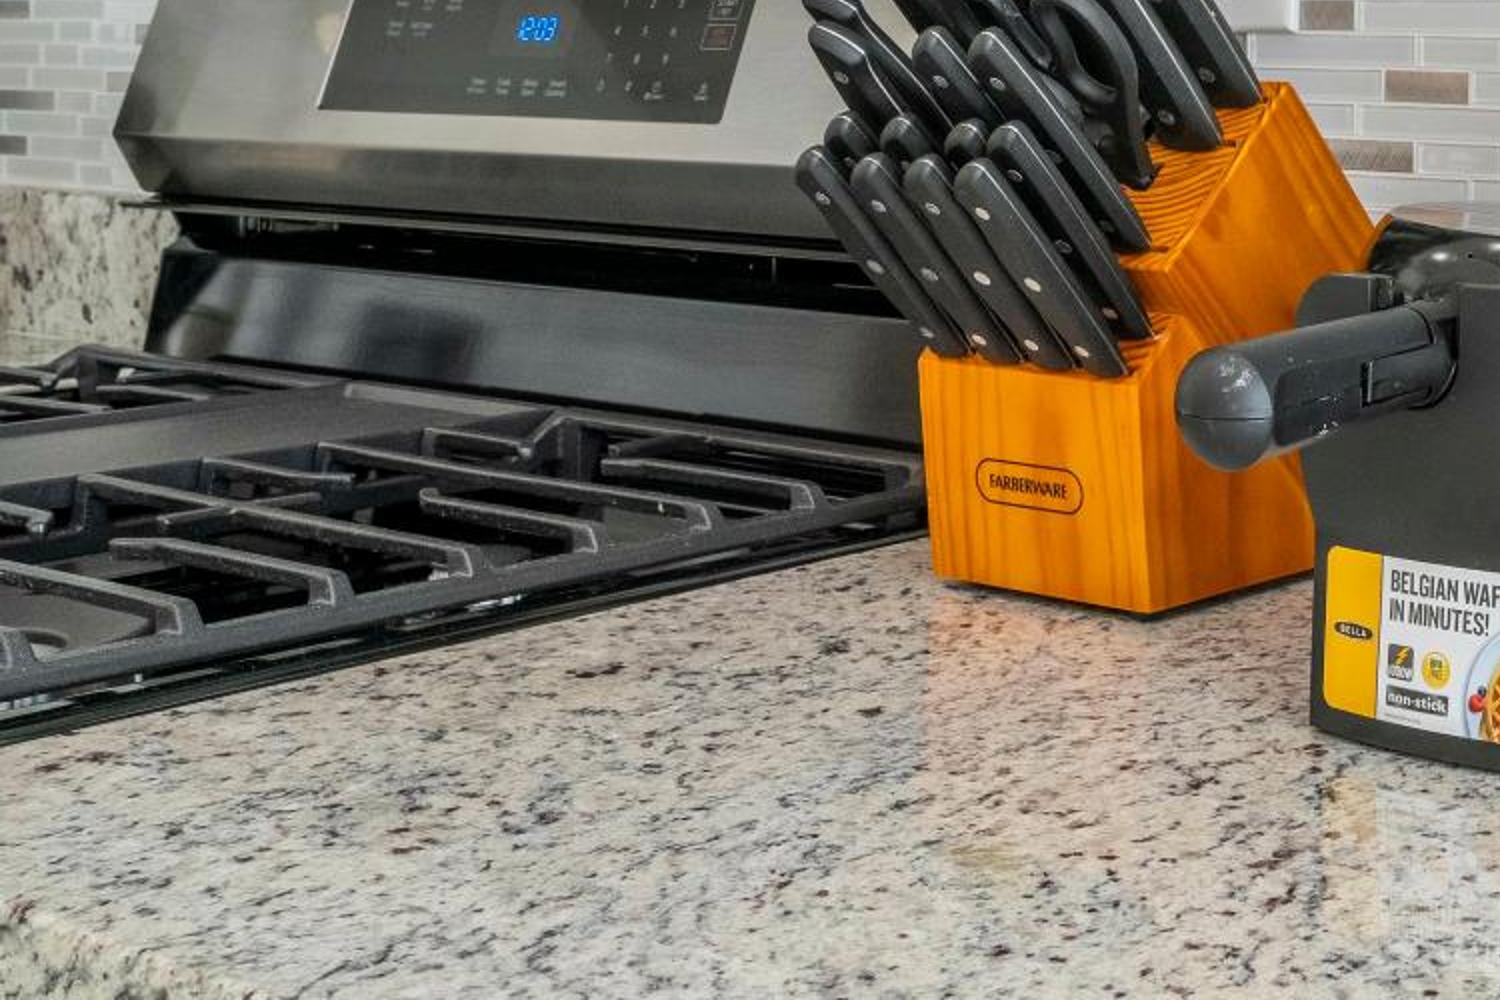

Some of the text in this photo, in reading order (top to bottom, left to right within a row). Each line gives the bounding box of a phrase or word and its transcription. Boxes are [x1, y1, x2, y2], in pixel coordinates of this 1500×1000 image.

[989, 473, 1069, 499] FARBERWARE
[1390, 569, 1459, 602] BELGIAN
[1338, 623, 1368, 637] BELLA
[1389, 597, 1490, 637] IN MINUTES!
[1387, 692, 1447, 713] non-stick
